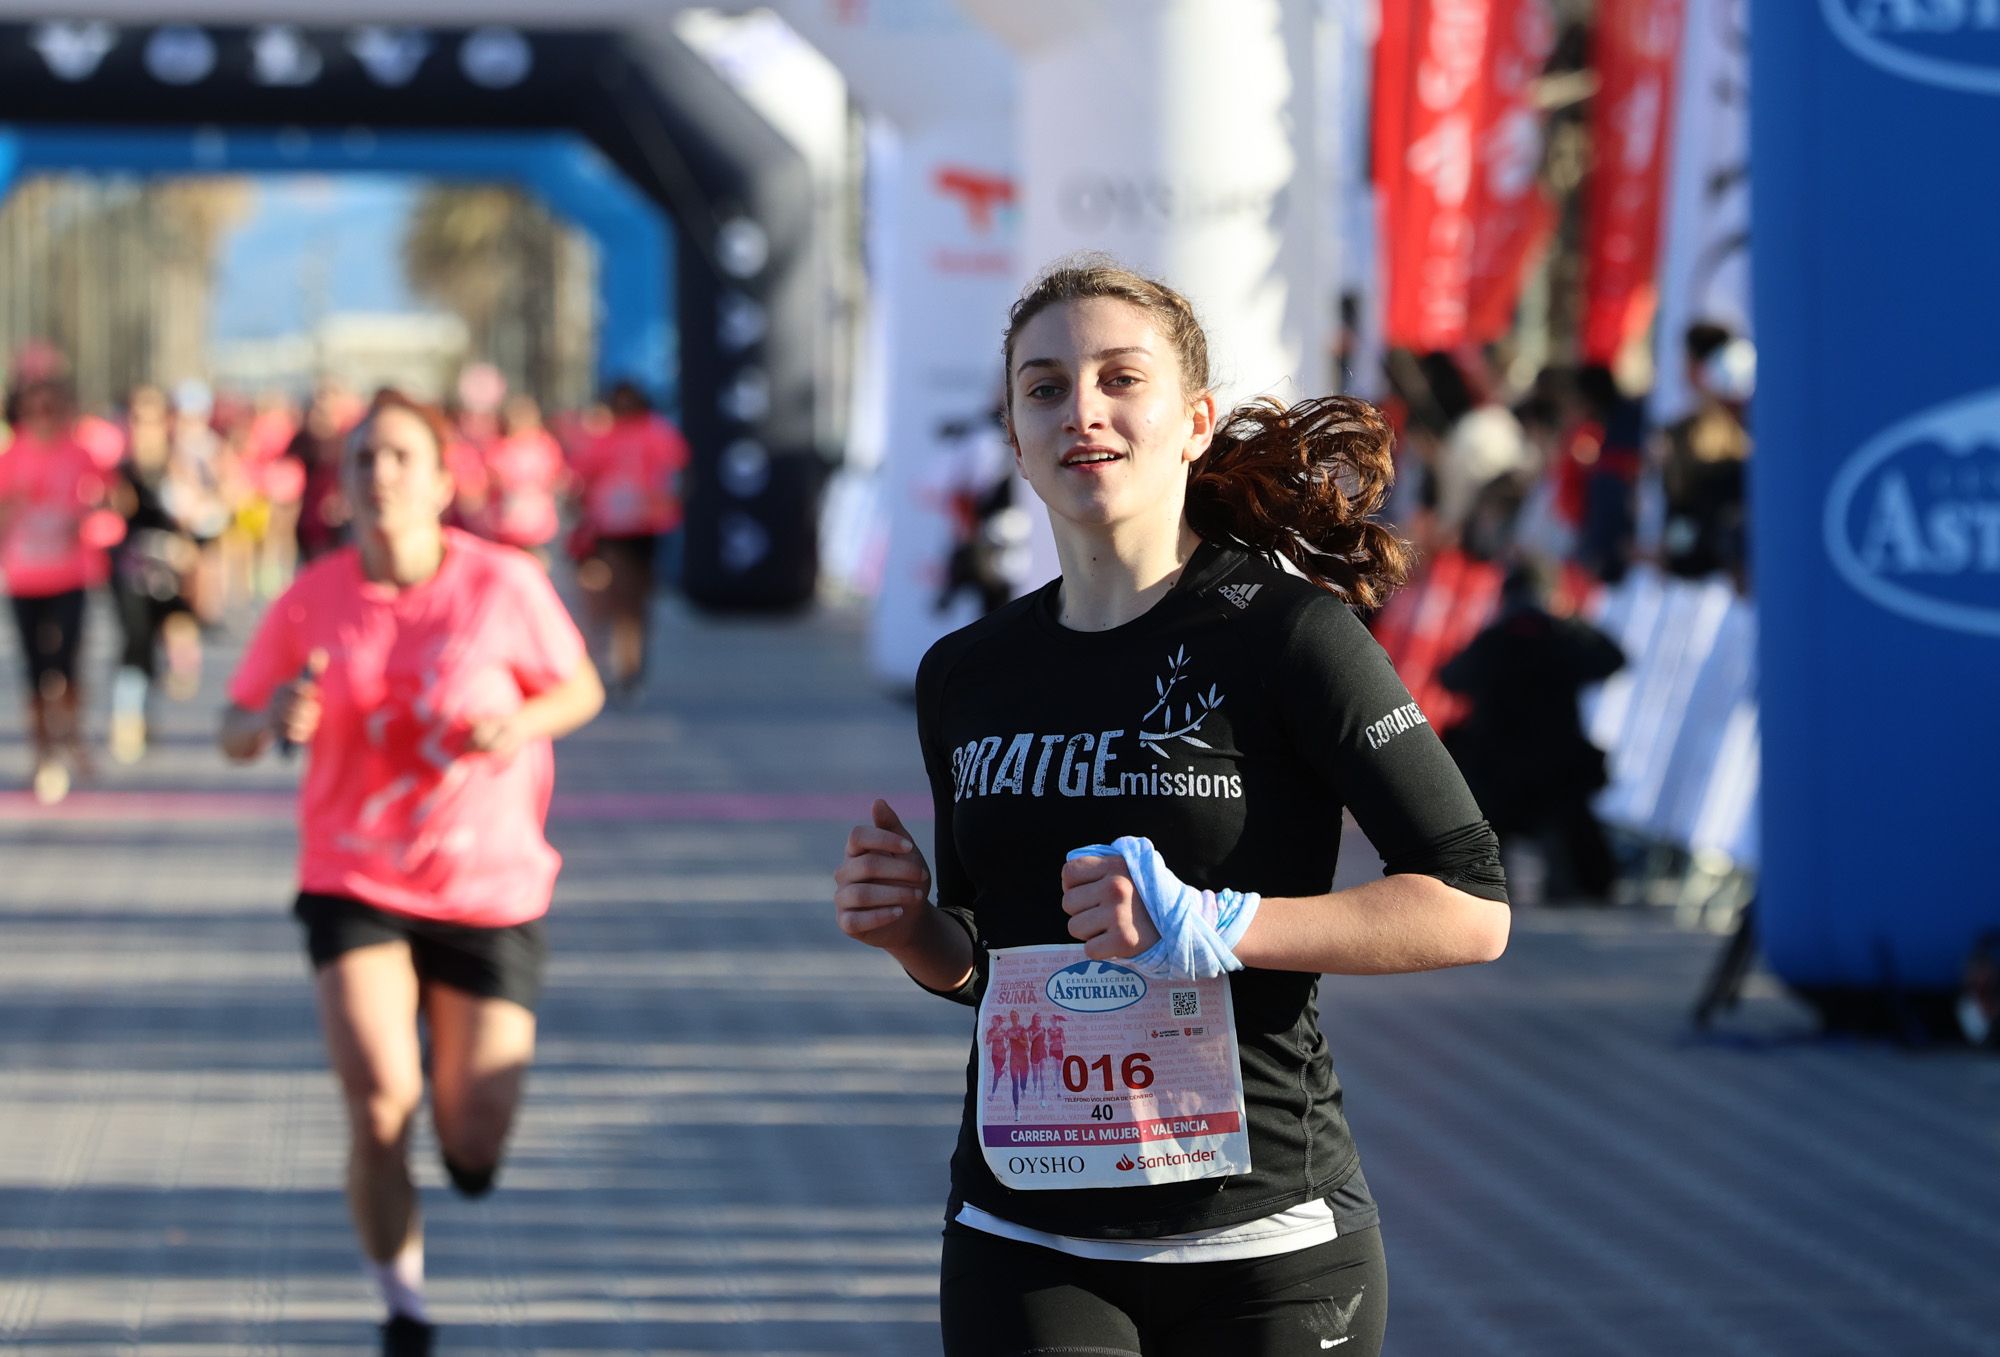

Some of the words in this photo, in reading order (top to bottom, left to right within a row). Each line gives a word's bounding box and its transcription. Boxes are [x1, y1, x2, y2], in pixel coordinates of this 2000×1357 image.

[1218, 585, 1249, 610] adidas
[1120, 764, 1242, 799] missions
[998, 990, 1038, 1005] SUMA
[1053, 979, 1140, 1000] ASTURIANA
[1062, 1052, 1155, 1093] 016
[1091, 1103, 1114, 1121] 40
[1010, 1129, 1061, 1143] CARRERA
[1064, 1128, 1080, 1142] DE
[1081, 1128, 1096, 1141] LA
[1099, 1127, 1140, 1141] MUJER
[1150, 1121, 1209, 1136] VALENCIA
[1008, 1155, 1085, 1175] OYSHO
[1137, 1150, 1217, 1170] Santander
